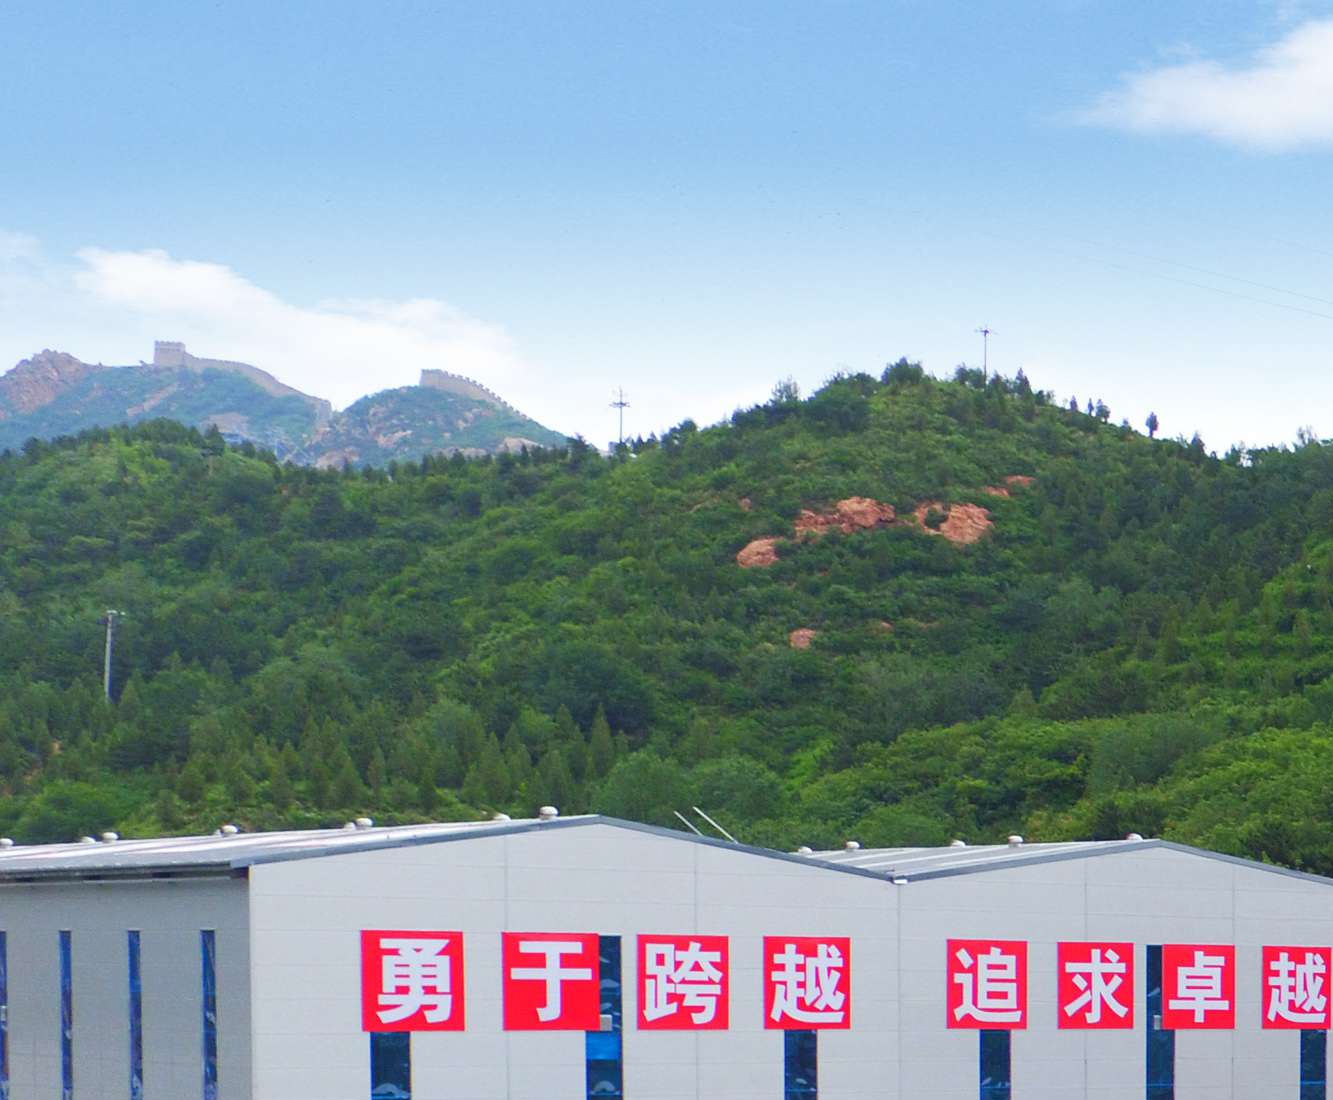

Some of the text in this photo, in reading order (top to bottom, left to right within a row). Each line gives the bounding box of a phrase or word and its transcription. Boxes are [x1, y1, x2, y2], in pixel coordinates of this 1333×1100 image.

[377, 939, 1326, 1024] 勇于跨越 追求卓越
